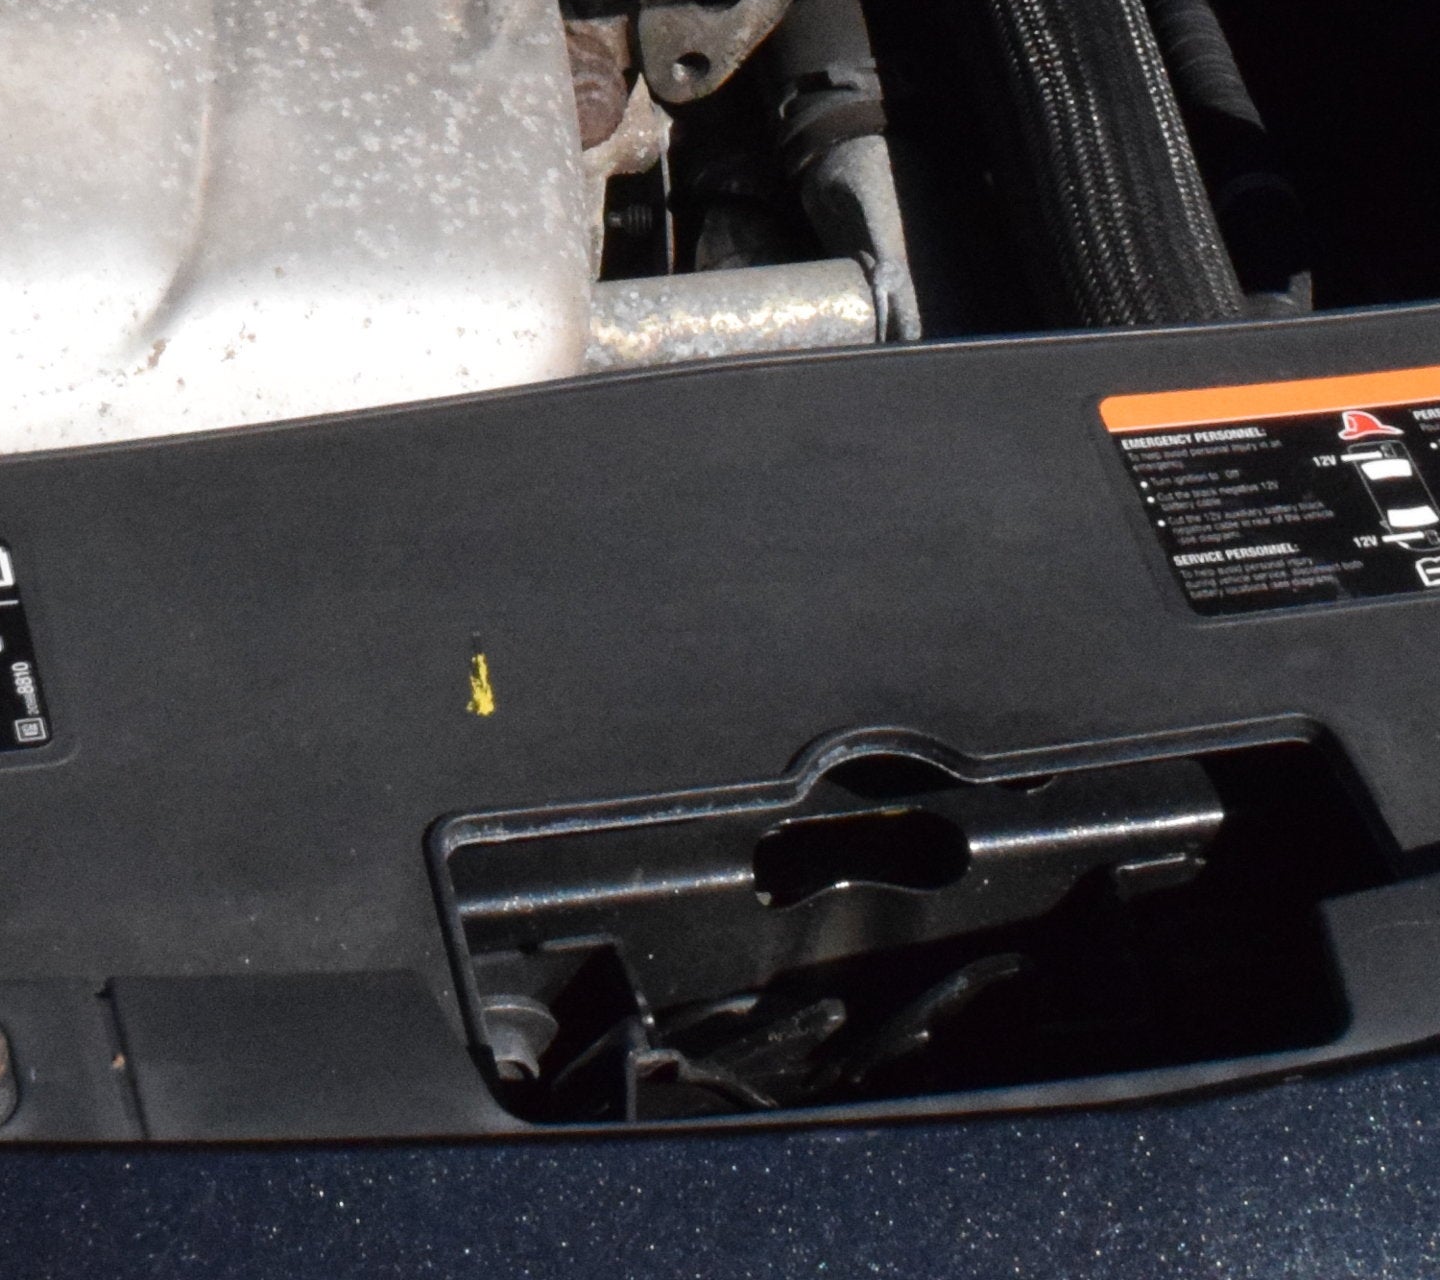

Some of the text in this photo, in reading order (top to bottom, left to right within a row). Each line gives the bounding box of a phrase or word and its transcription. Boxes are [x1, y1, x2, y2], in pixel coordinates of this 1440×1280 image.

[1121, 426, 1267, 450] EMERGENCY PERSONNEL:
[1312, 455, 1337, 467] 12V
[1353, 535, 1379, 549] 12V
[1173, 542, 1301, 566] SERVICE PERSONNEL:
